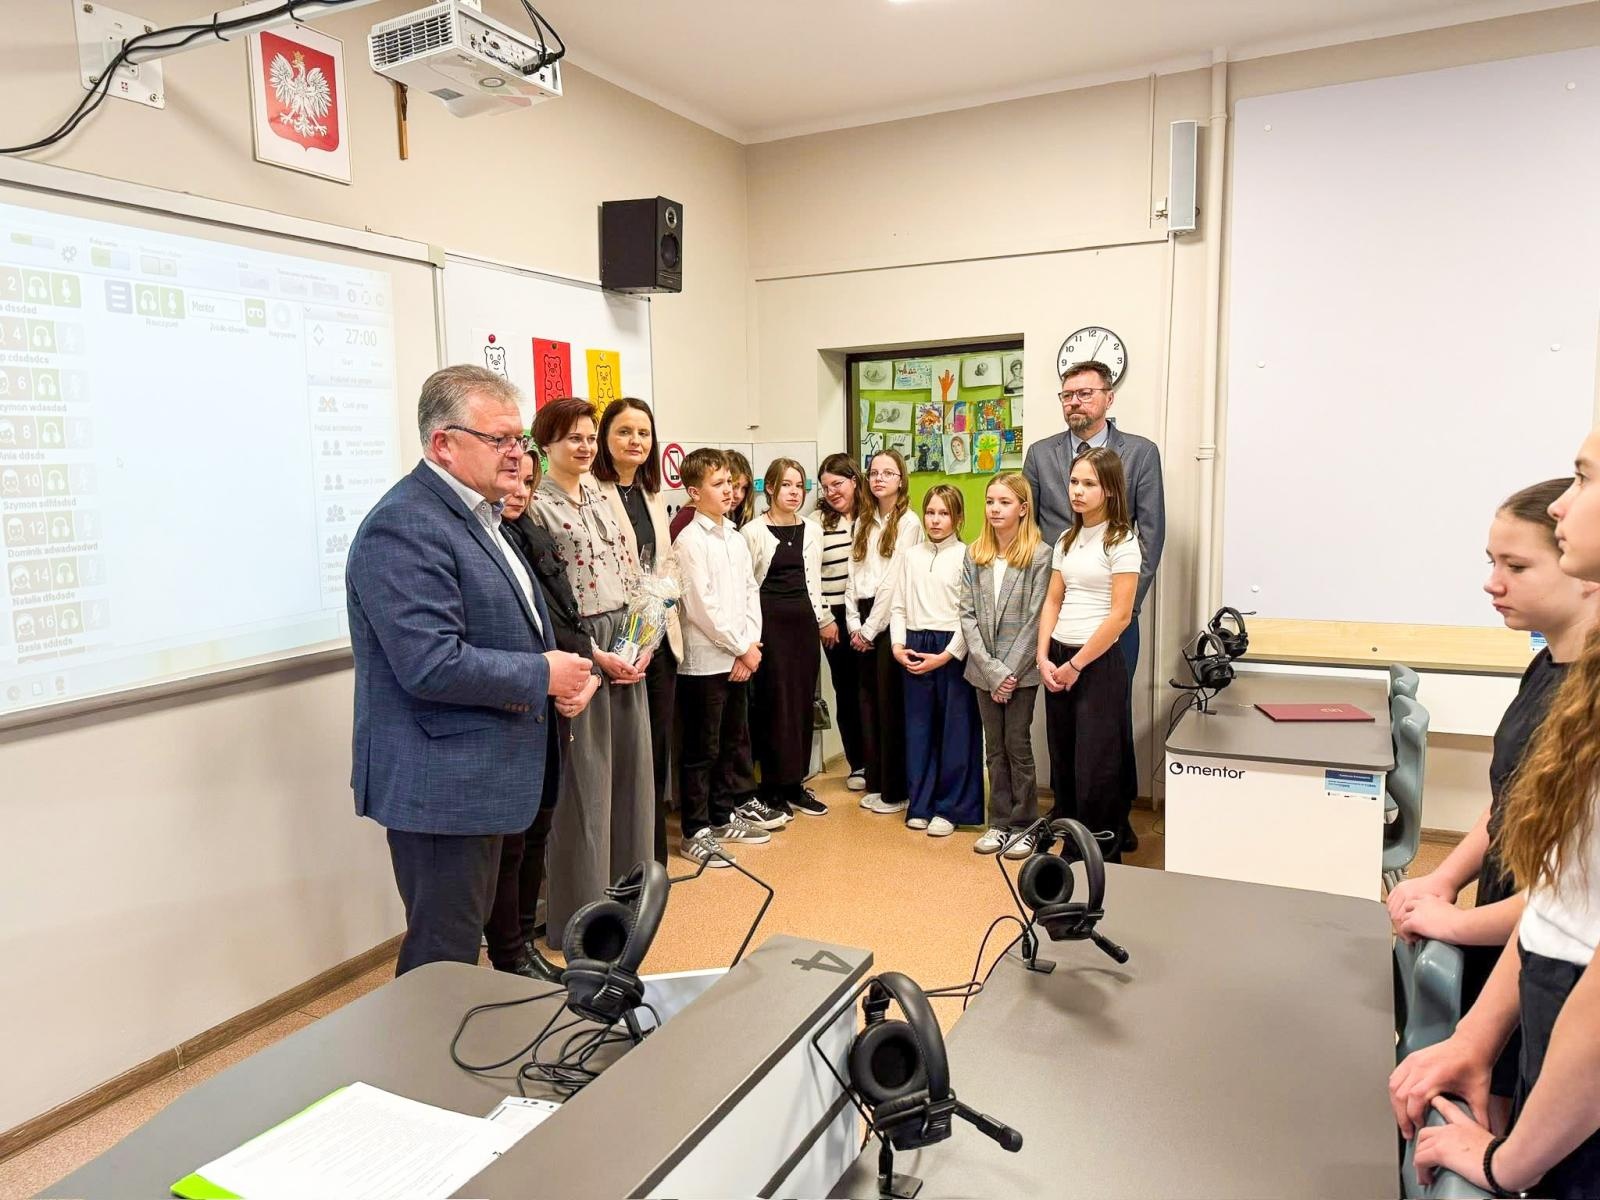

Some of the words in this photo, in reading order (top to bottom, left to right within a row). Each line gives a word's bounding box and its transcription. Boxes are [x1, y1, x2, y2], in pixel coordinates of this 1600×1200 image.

[7, 276, 17, 291] 2
[13, 327, 22, 341] 4
[345, 328, 377, 347] 27:00
[17, 376, 27, 390] 6
[22, 424, 31, 439] 8
[23, 473, 40, 488] 10
[28, 521, 45, 536] 12
[33, 568, 49, 583] 14
[39, 615, 55, 629] 16
[1186, 766, 1245, 779] mentor
[791, 950, 854, 975] 4
